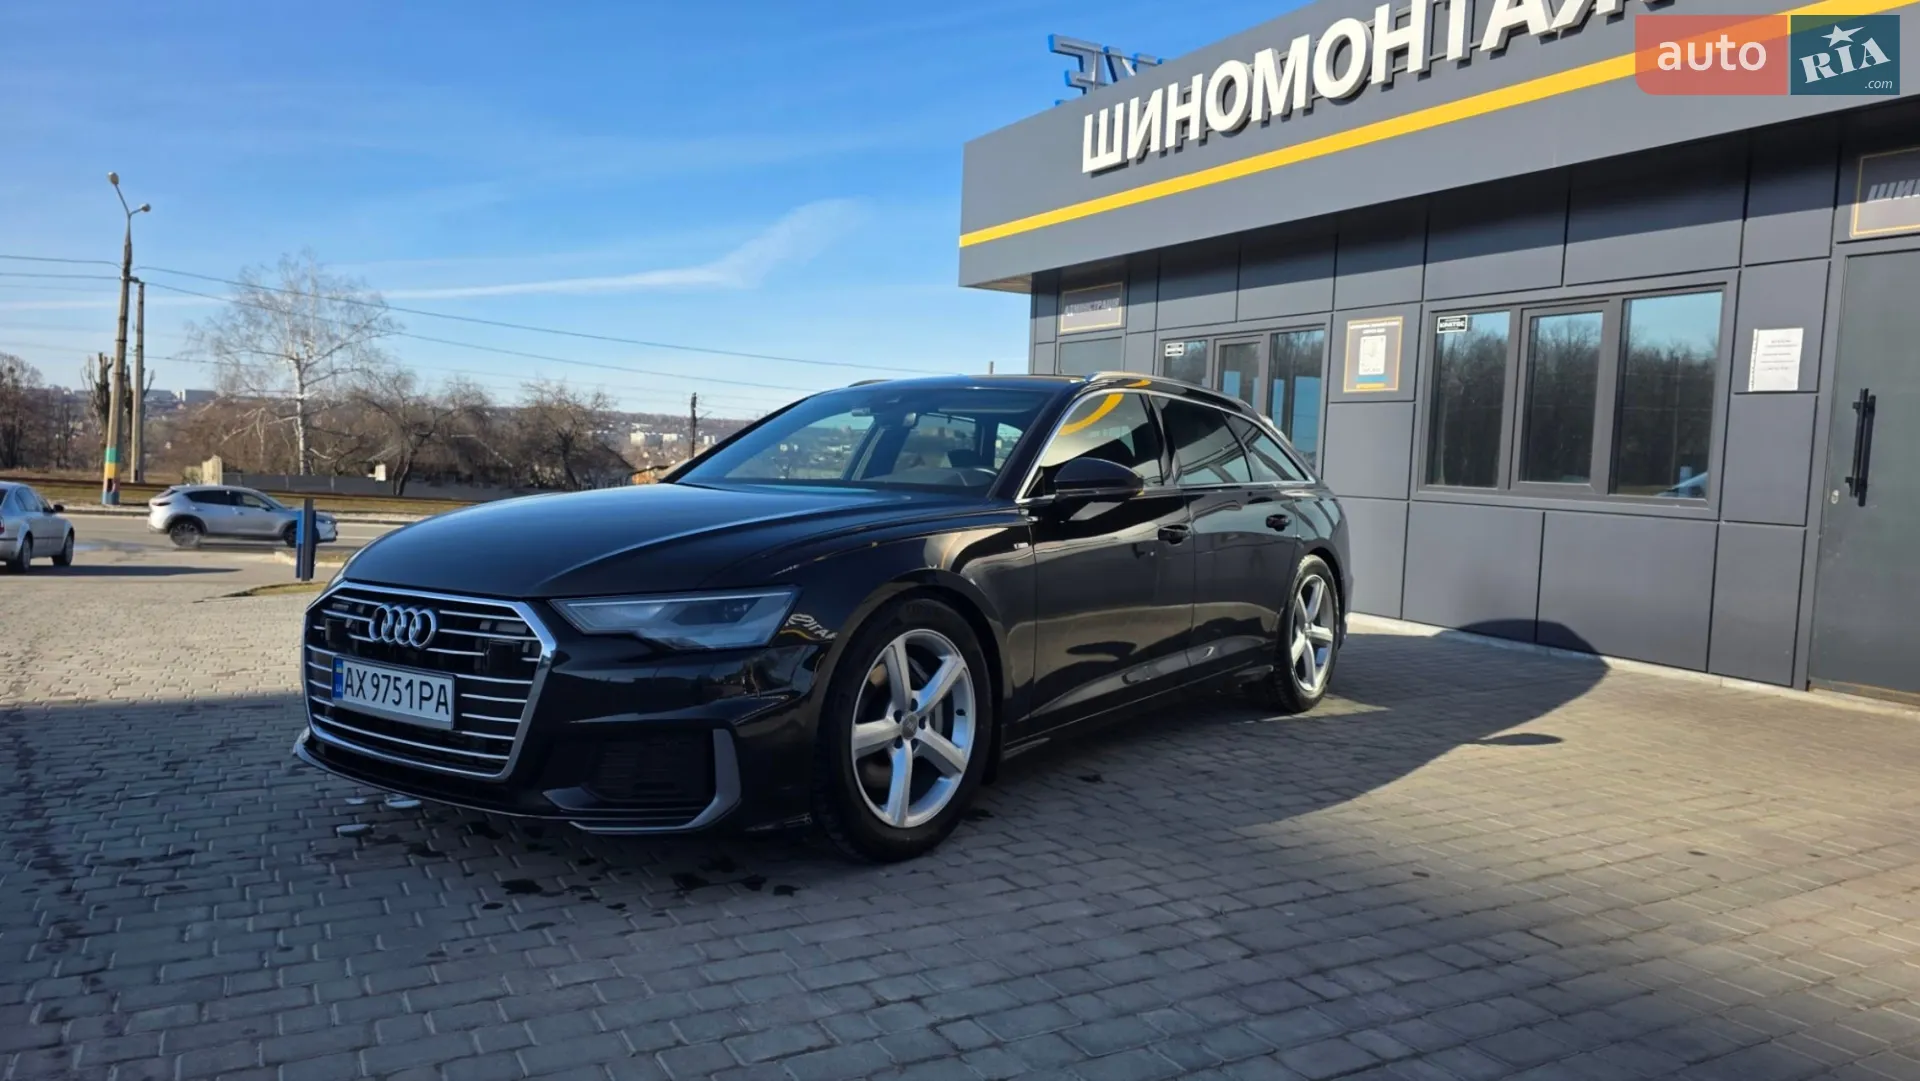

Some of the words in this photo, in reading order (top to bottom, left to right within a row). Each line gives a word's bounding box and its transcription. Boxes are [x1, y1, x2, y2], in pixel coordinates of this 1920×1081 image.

[344, 667, 367, 700] AX
[370, 672, 414, 709] 9751
[419, 680, 449, 715] PA
